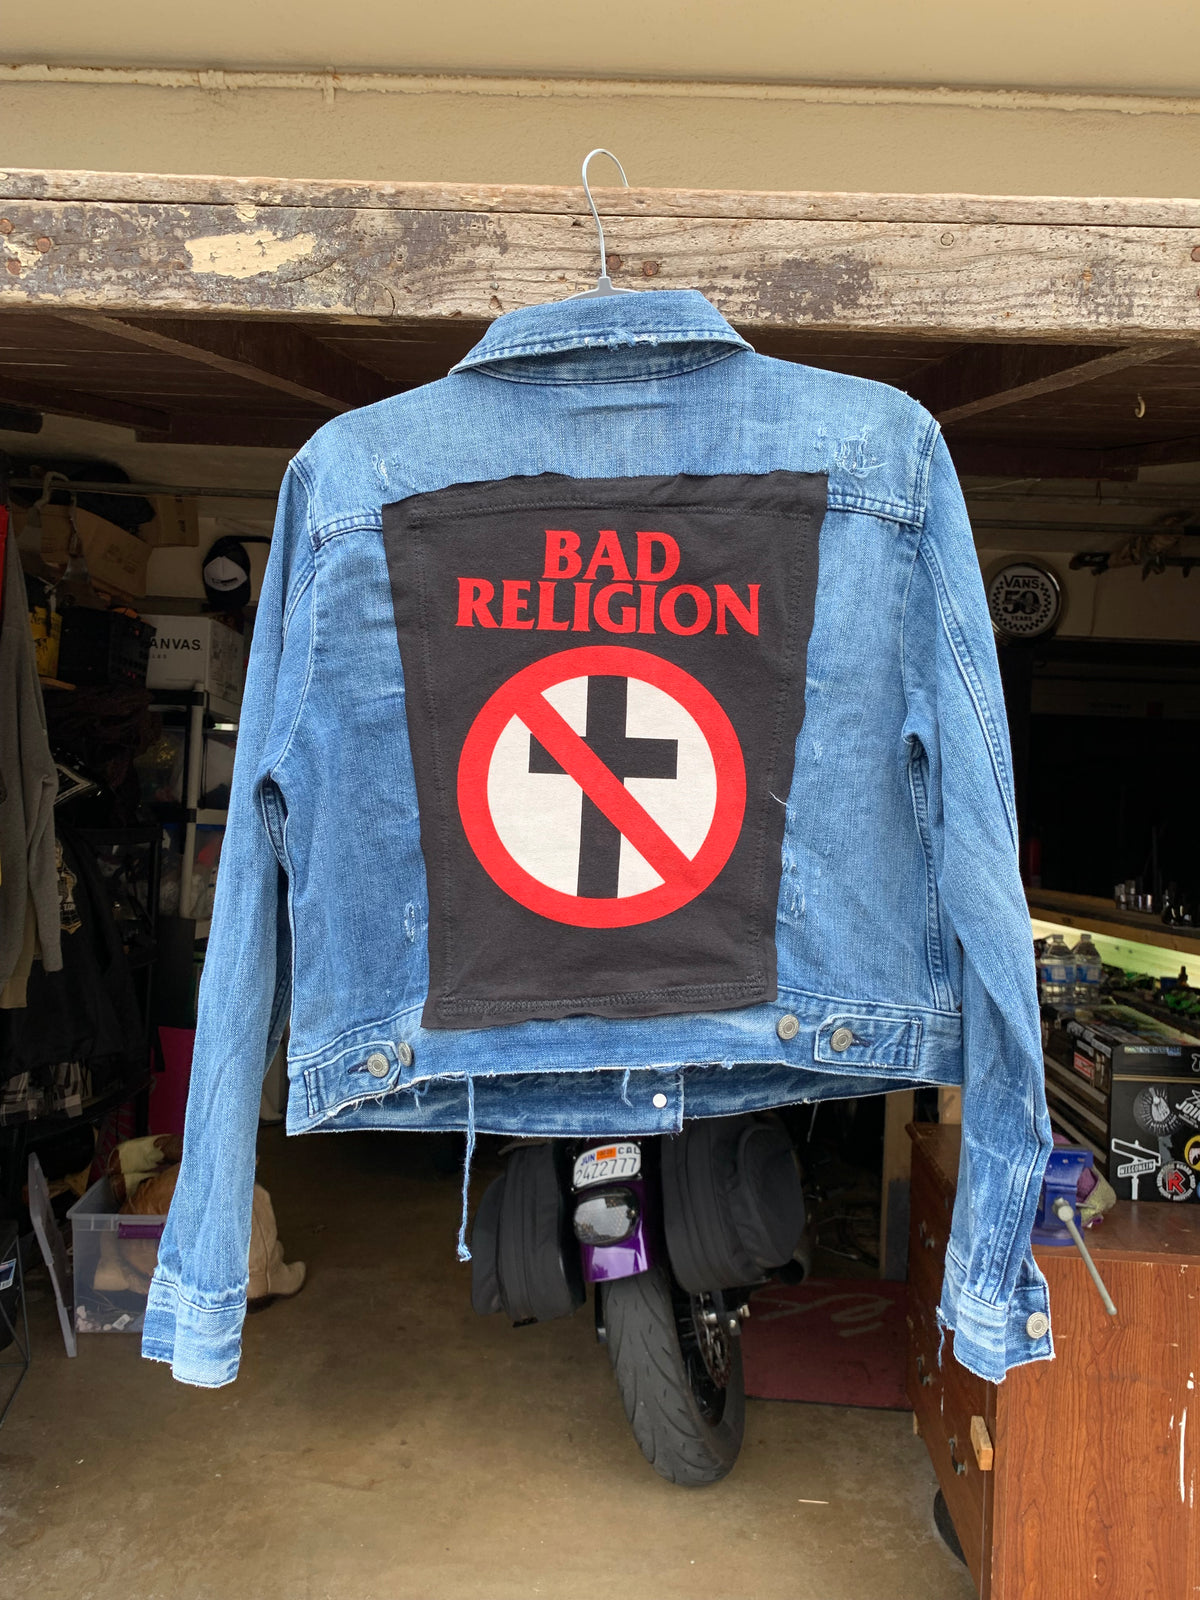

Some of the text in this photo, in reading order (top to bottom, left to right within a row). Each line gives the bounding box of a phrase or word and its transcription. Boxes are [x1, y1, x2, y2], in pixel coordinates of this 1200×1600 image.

[542, 530, 680, 582] BAD
[1003, 575, 1040, 589] VANS
[455, 577, 761, 636] RELIGION
[1002, 590, 1040, 614] 50
[149, 638, 201, 650] ANVAS
[581, 1153, 596, 1166] JUN
[618, 1146, 641, 1155] CAL
[1119, 1162, 1154, 1175] WISCONSIN
